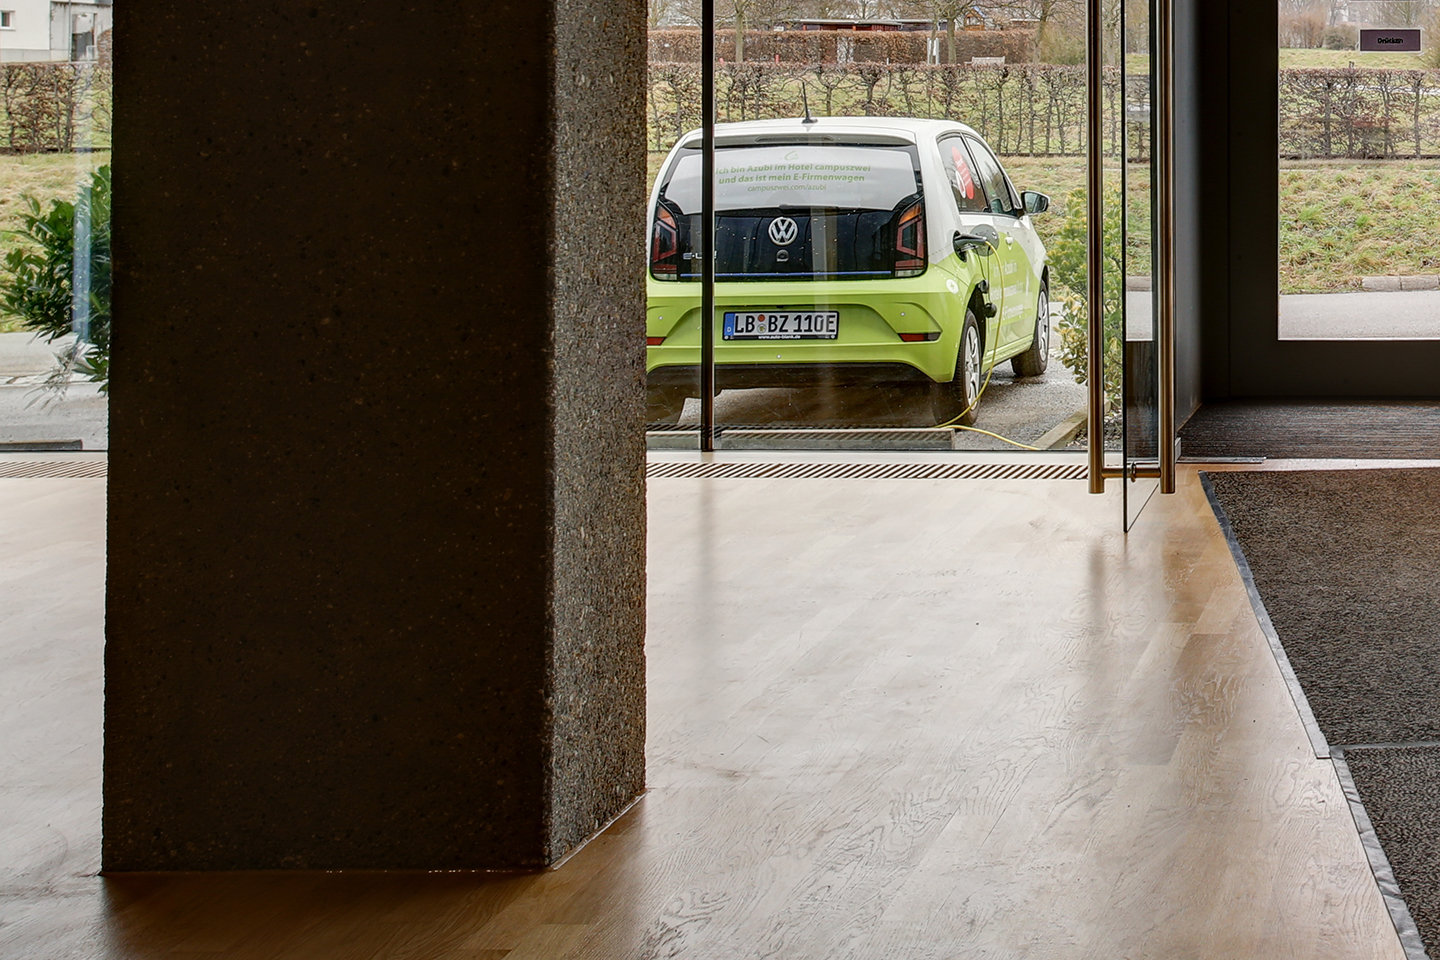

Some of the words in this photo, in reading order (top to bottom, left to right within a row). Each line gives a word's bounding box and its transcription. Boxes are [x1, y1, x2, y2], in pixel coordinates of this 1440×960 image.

[716, 167, 729, 175] Ich
[747, 164, 772, 172] Azubi
[788, 163, 813, 171] Hotel
[815, 164, 871, 172] campuszwei
[718, 176, 736, 184] und
[738, 175, 754, 183] das
[756, 174, 767, 182] ist
[768, 173, 792, 181] mein
[793, 173, 865, 183] E-Firmenwagen
[747, 184, 827, 193] campuszwei.com/azubi
[735, 315, 756, 333] LB
[768, 315, 789, 333] BZ
[793, 315, 836, 333] 110E
